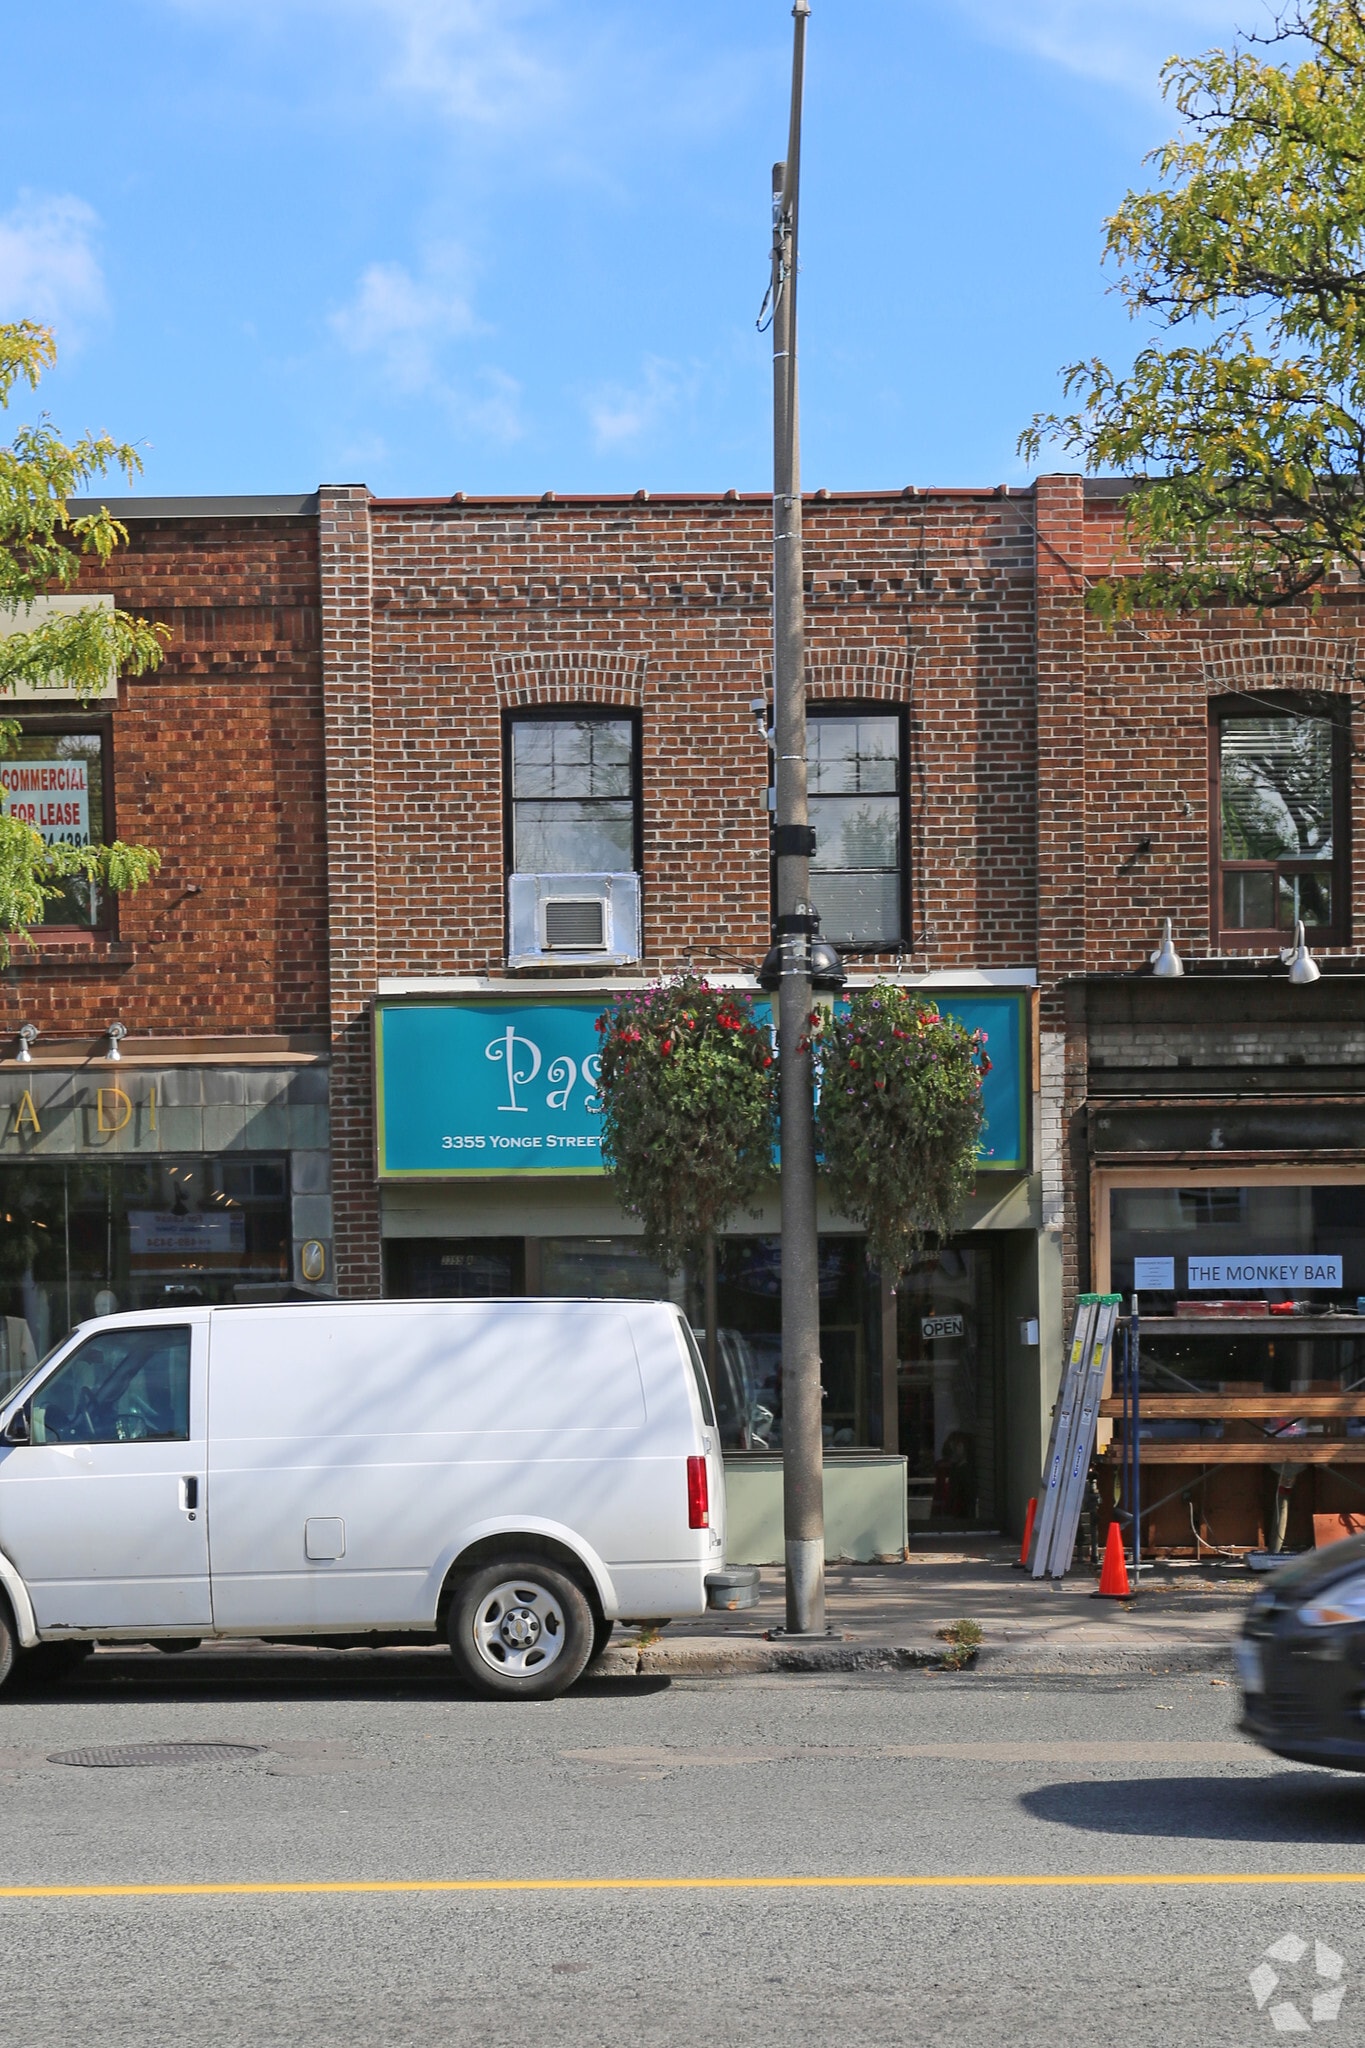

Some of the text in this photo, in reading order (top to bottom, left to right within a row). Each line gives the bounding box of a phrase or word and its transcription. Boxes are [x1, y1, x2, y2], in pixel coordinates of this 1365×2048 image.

[2, 769, 87, 790] COMMERCIAL
[10, 803, 80, 825] FOR LEASE
[485, 1026, 607, 1113] Pas
[442, 1136, 486, 1149] 3355
[1189, 1266, 1220, 1281] THE
[1226, 1265, 1298, 1281] MONKEY
[1305, 1265, 1337, 1280] BAR
[923, 1321, 962, 1336] OPEN
